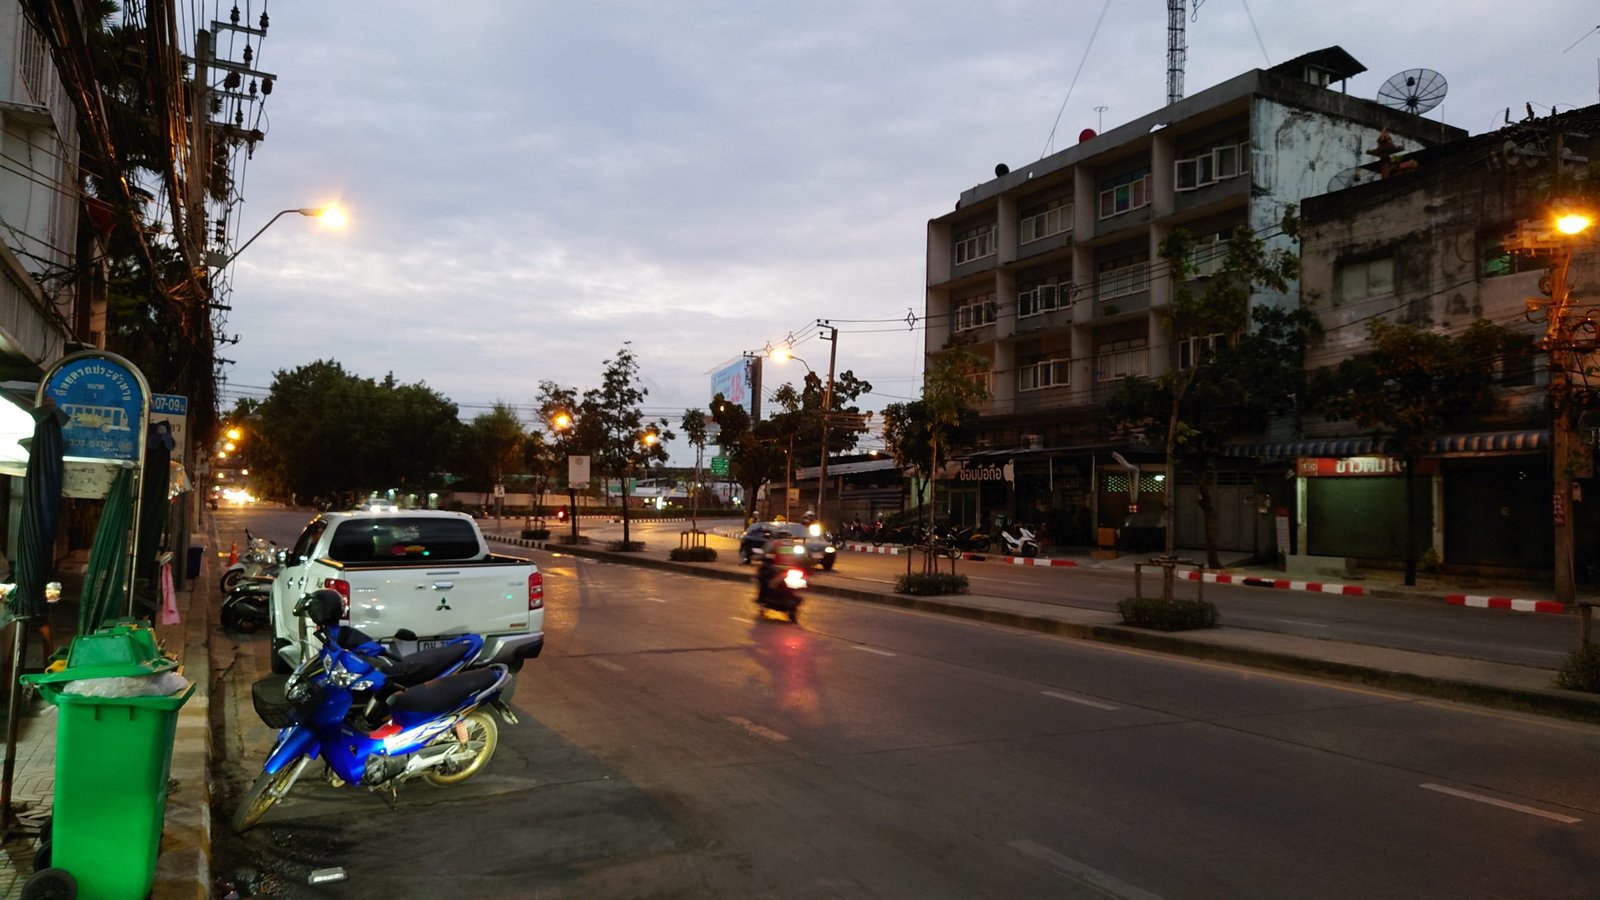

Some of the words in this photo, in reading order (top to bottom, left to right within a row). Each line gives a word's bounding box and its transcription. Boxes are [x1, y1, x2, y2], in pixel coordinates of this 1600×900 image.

[155, 397, 180, 411] 07-09
[959, 460, 1002, 481] ซ่อมมือถือ
